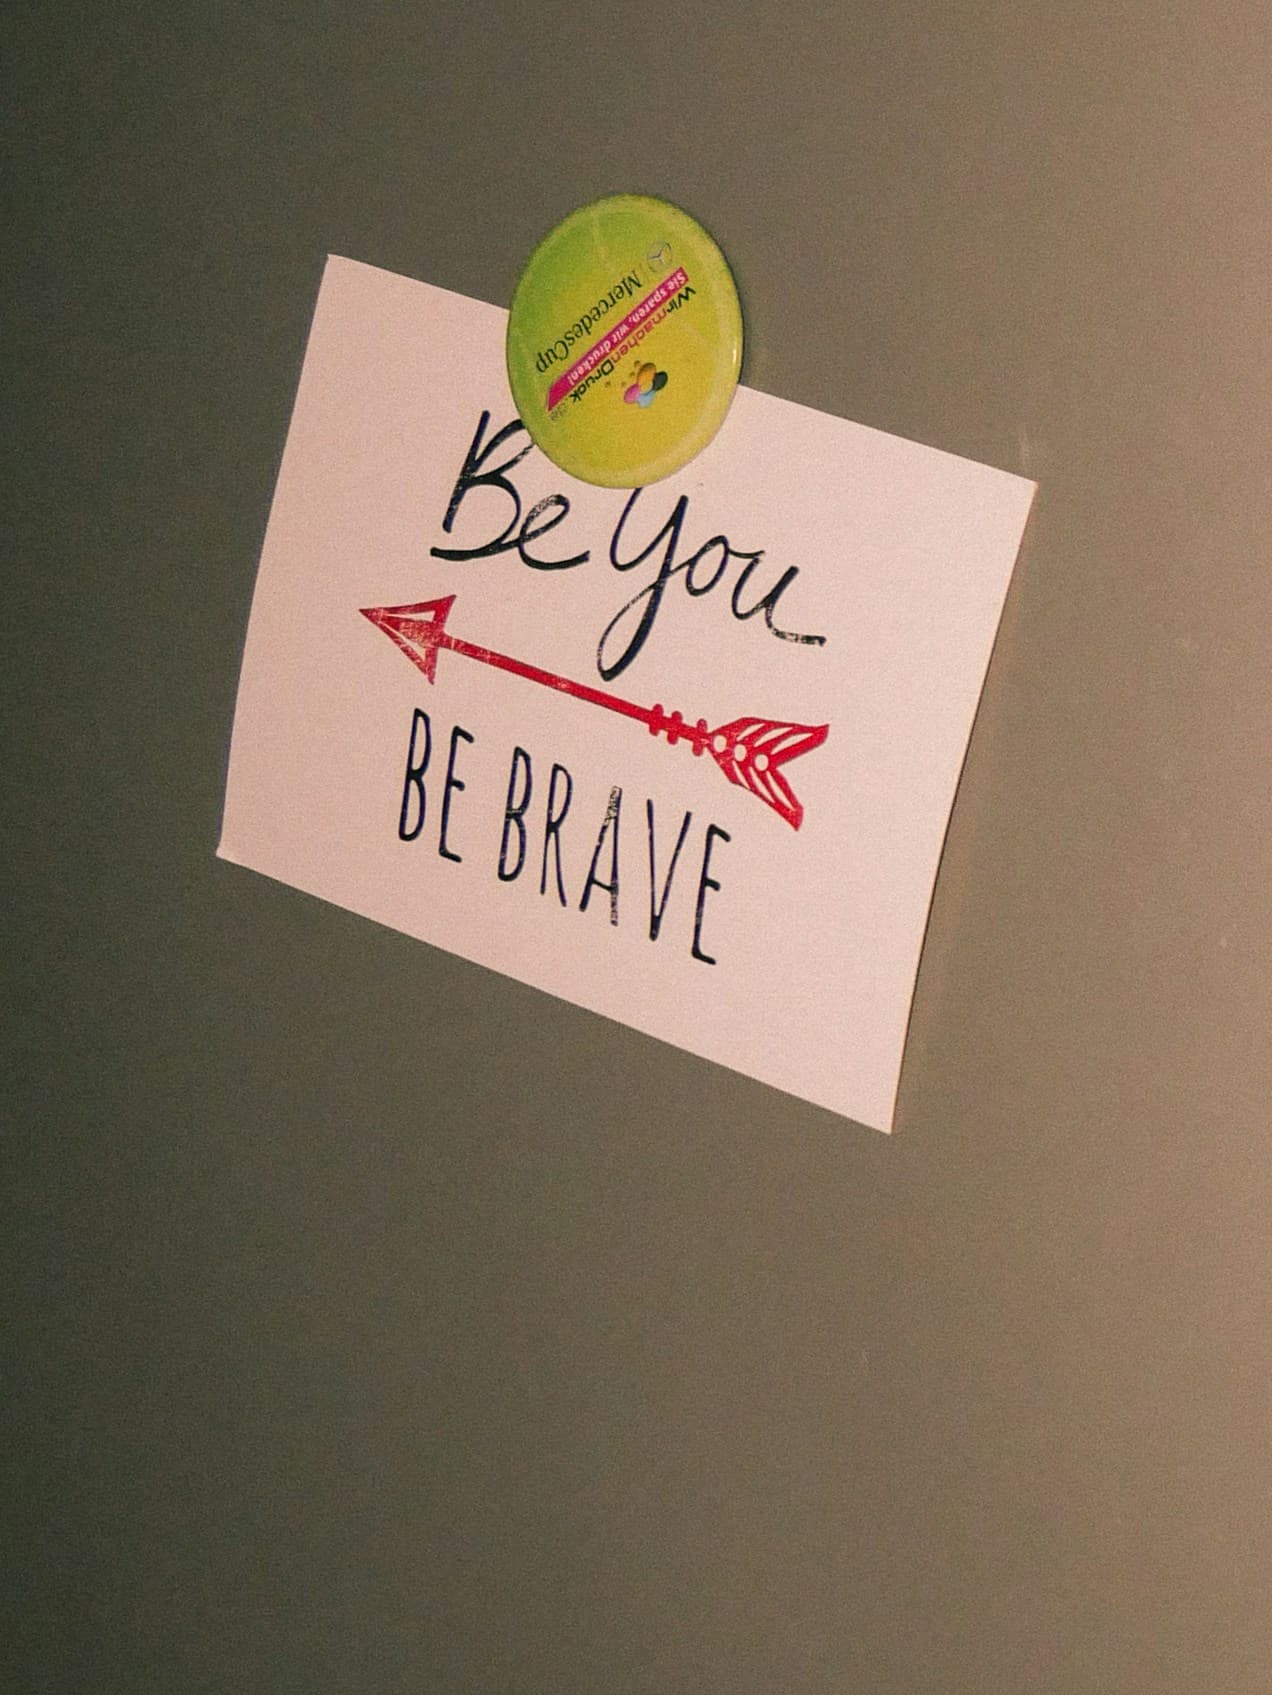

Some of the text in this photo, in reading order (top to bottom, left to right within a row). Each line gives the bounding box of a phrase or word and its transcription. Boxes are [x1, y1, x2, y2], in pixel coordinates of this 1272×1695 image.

[535, 270, 643, 373] MercedesCup
[567, 271, 687, 386] Sie sparen, wir drucken!
[430, 409, 827, 682] Be You
[399, 708, 733, 966] BE BRAVE
